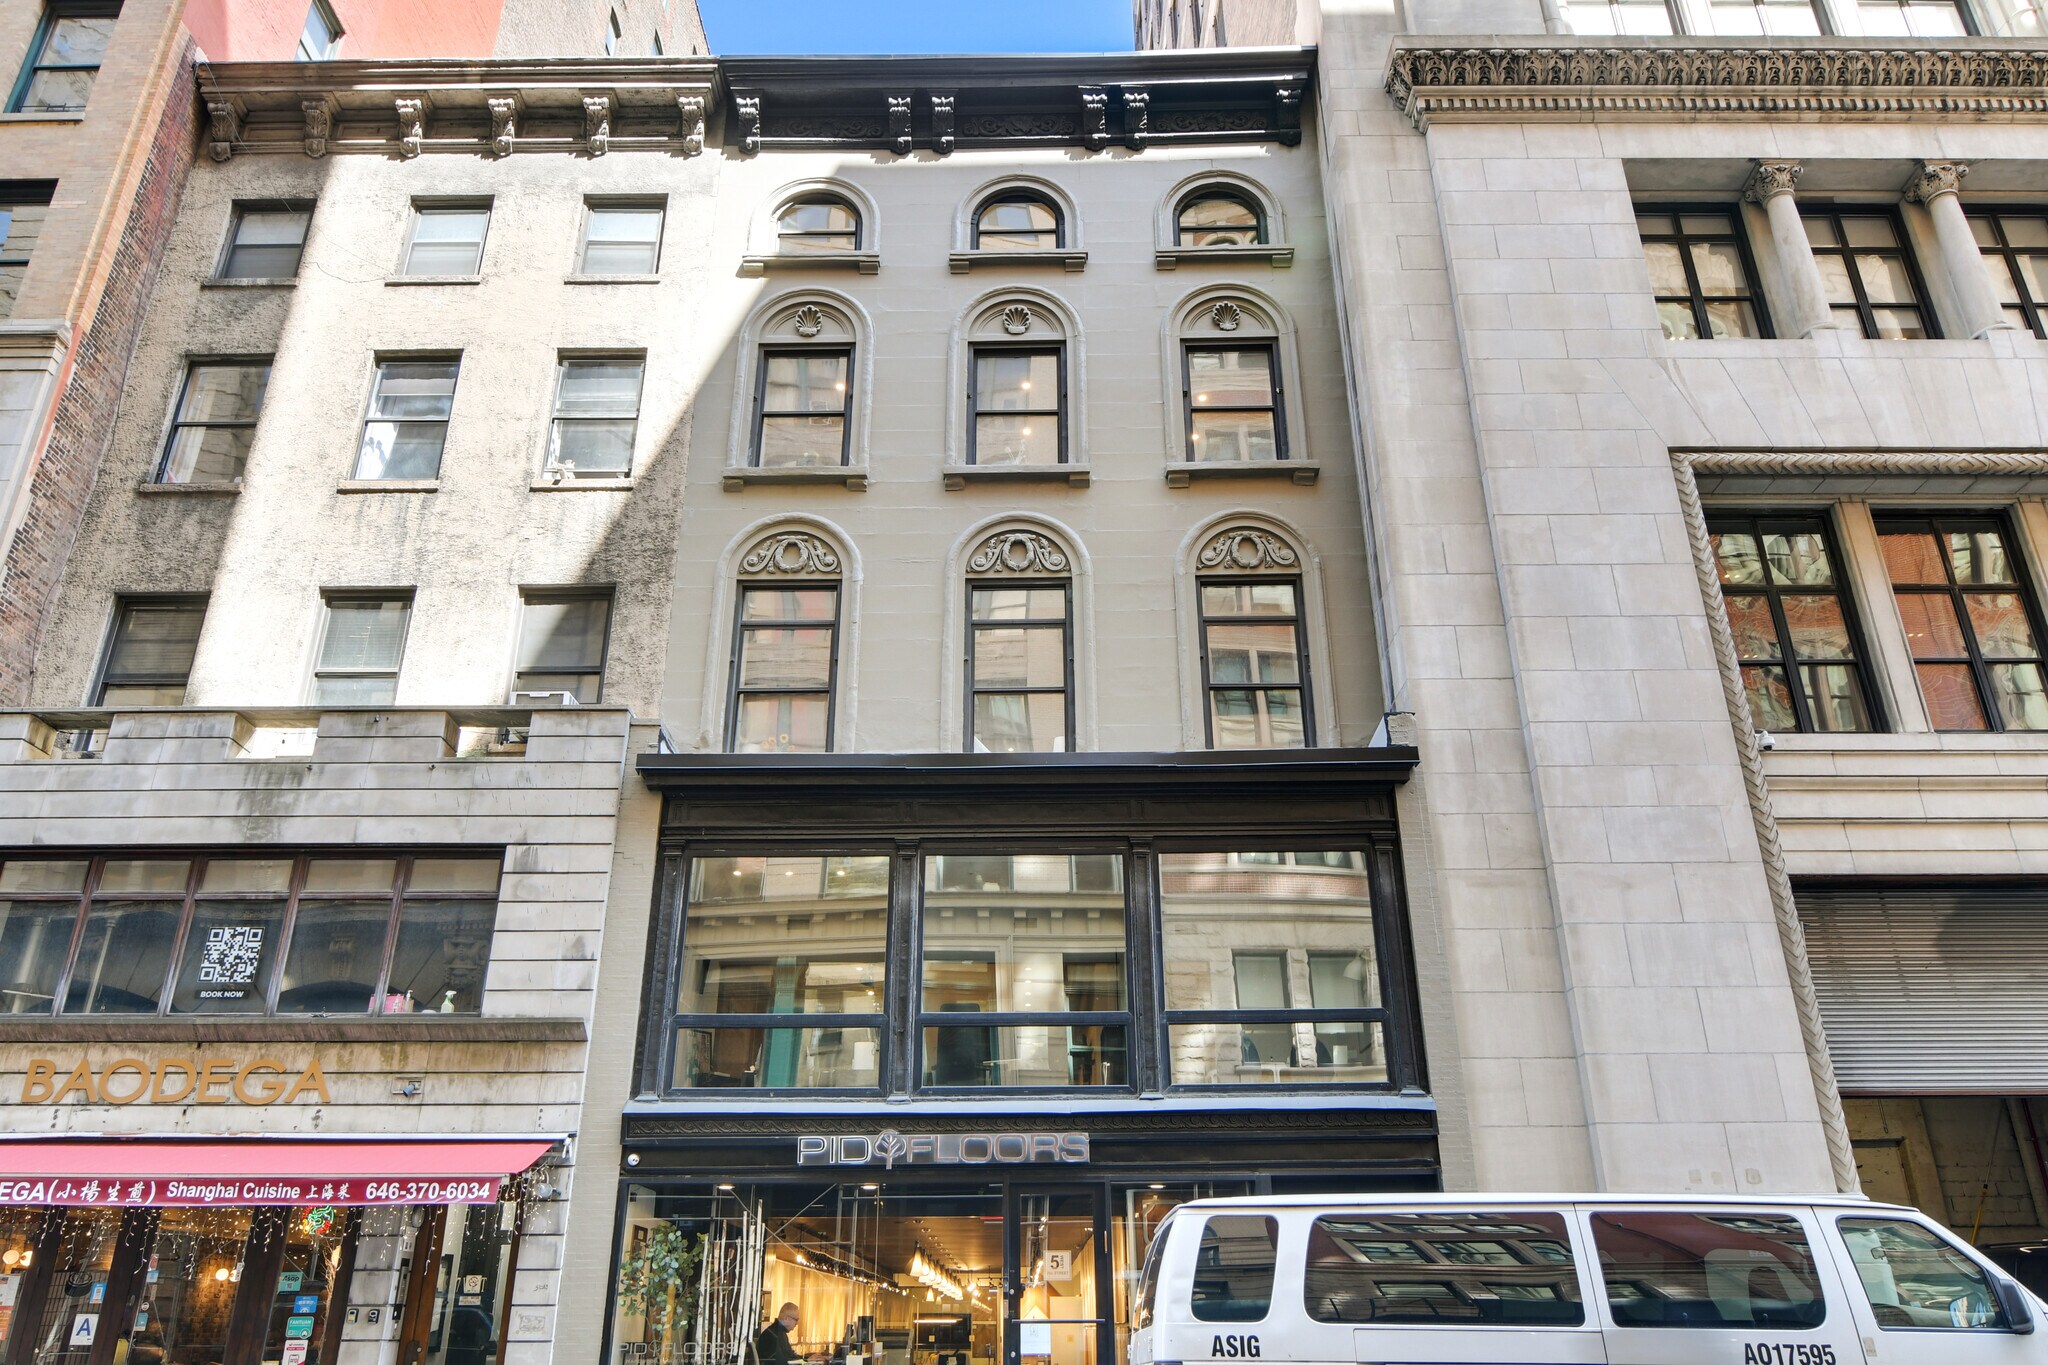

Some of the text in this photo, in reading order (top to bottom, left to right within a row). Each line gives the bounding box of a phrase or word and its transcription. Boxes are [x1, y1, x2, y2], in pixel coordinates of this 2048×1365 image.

[20, 1058, 331, 1104] BAODEGA
[797, 1132, 1091, 1164] PID FLOORS
[167, 1181, 240, 1201] Shanghai
[243, 1182, 300, 1199] Cuisine
[305, 1183, 351, 1200] 上海菜
[365, 1182, 490, 1199] 646-370-6034
[1050, 1255, 1060, 1270] 5
[75, 1317, 92, 1337] A
[619, 1342, 738, 1355] PID FLOORS
[1211, 1335, 1261, 1358] ASIG
[1744, 1342, 1837, 1365] A017595
